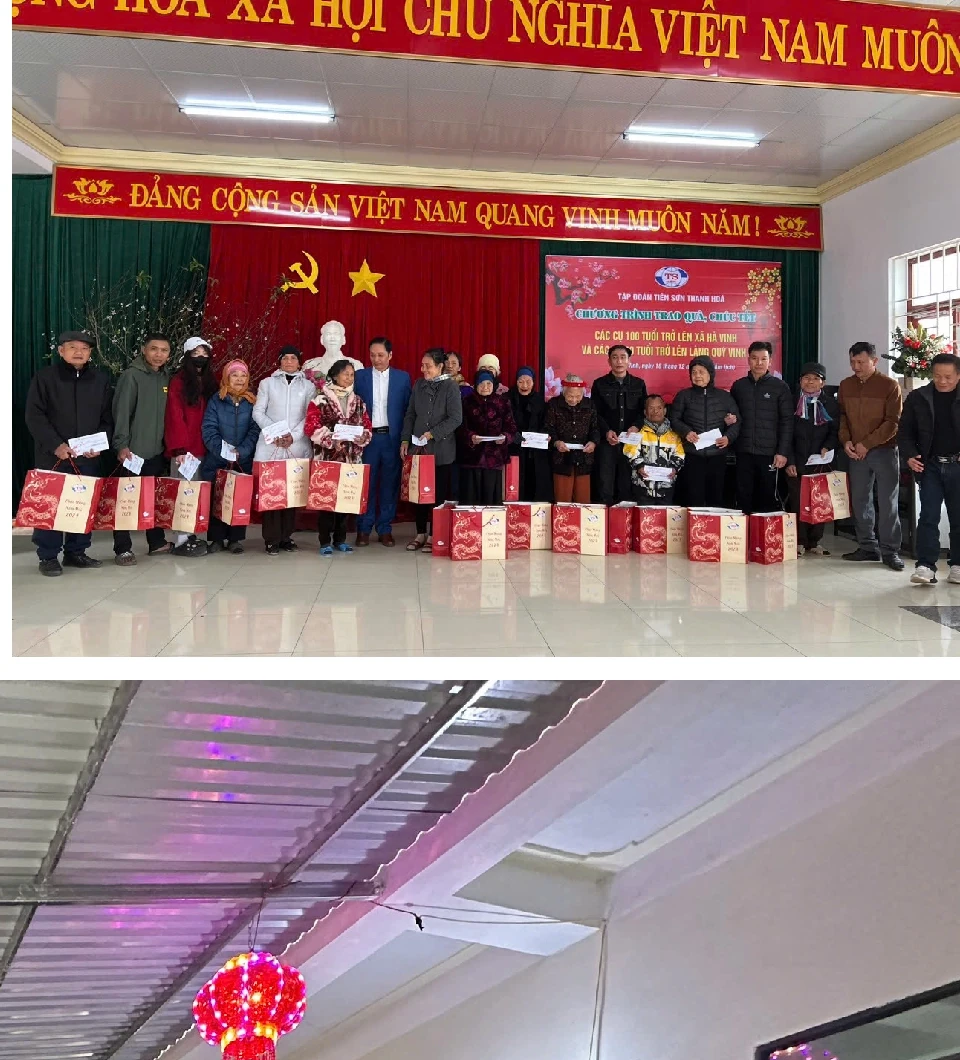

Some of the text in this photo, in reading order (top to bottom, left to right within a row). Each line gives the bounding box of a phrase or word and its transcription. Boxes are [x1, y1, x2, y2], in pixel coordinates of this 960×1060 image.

[651, 0, 746, 69] VIỆT
[760, 18, 848, 66] NAM
[130, 175, 200, 210] ĐẢNG
[211, 183, 279, 218] CỘNG
[290, 183, 340, 216] SẢN
[350, 190, 405, 225] VIỆT
[414, 199, 467, 224] NAM
[475, 201, 554, 230] QUANG
[564, 206, 620, 231] VINH
[627, 205, 692, 234] MUÔN
[654, 310, 682, 321] TRAO
[595, 330, 610, 341] CÁC
[613, 331, 623, 343] CỤ
[720, 333, 737, 343] VINH
[729, 347, 746, 358] VINH
